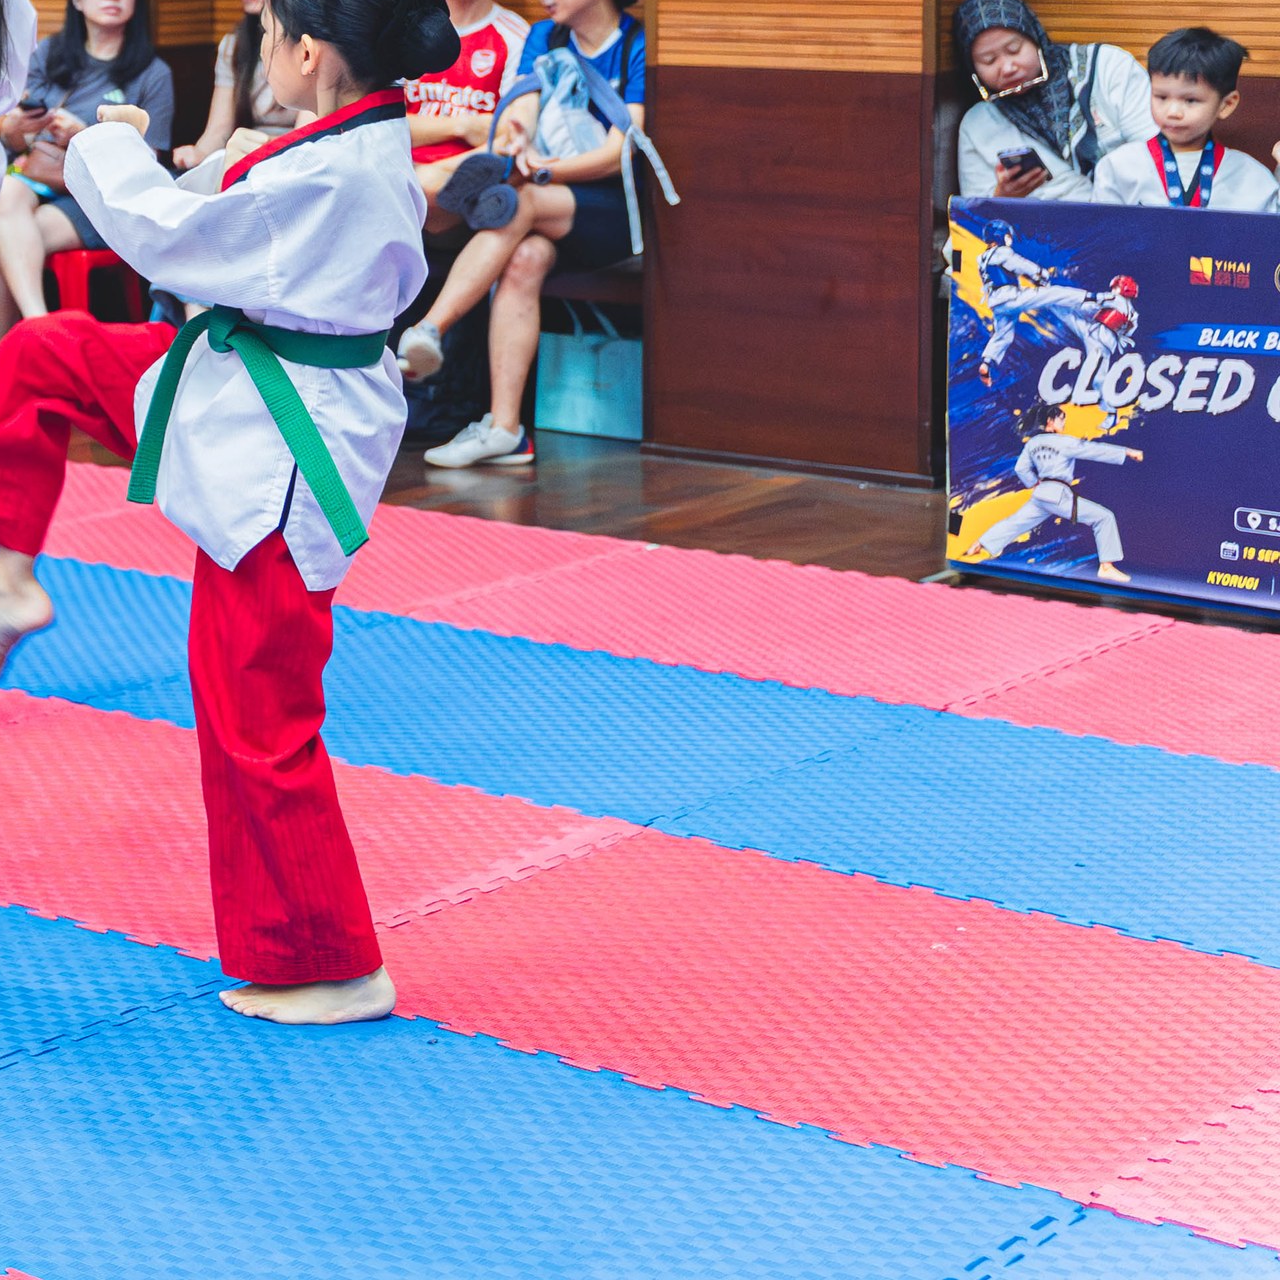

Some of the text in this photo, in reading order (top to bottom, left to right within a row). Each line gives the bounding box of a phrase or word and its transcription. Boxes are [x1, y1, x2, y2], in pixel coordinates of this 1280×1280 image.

[406, 78, 496, 111] Emirates
[1214, 260, 1251, 273] YIHAI
[1197, 327, 1260, 349] BLACK
[1037, 346, 1256, 415] CLOSED
[1242, 546, 1256, 560] 19
